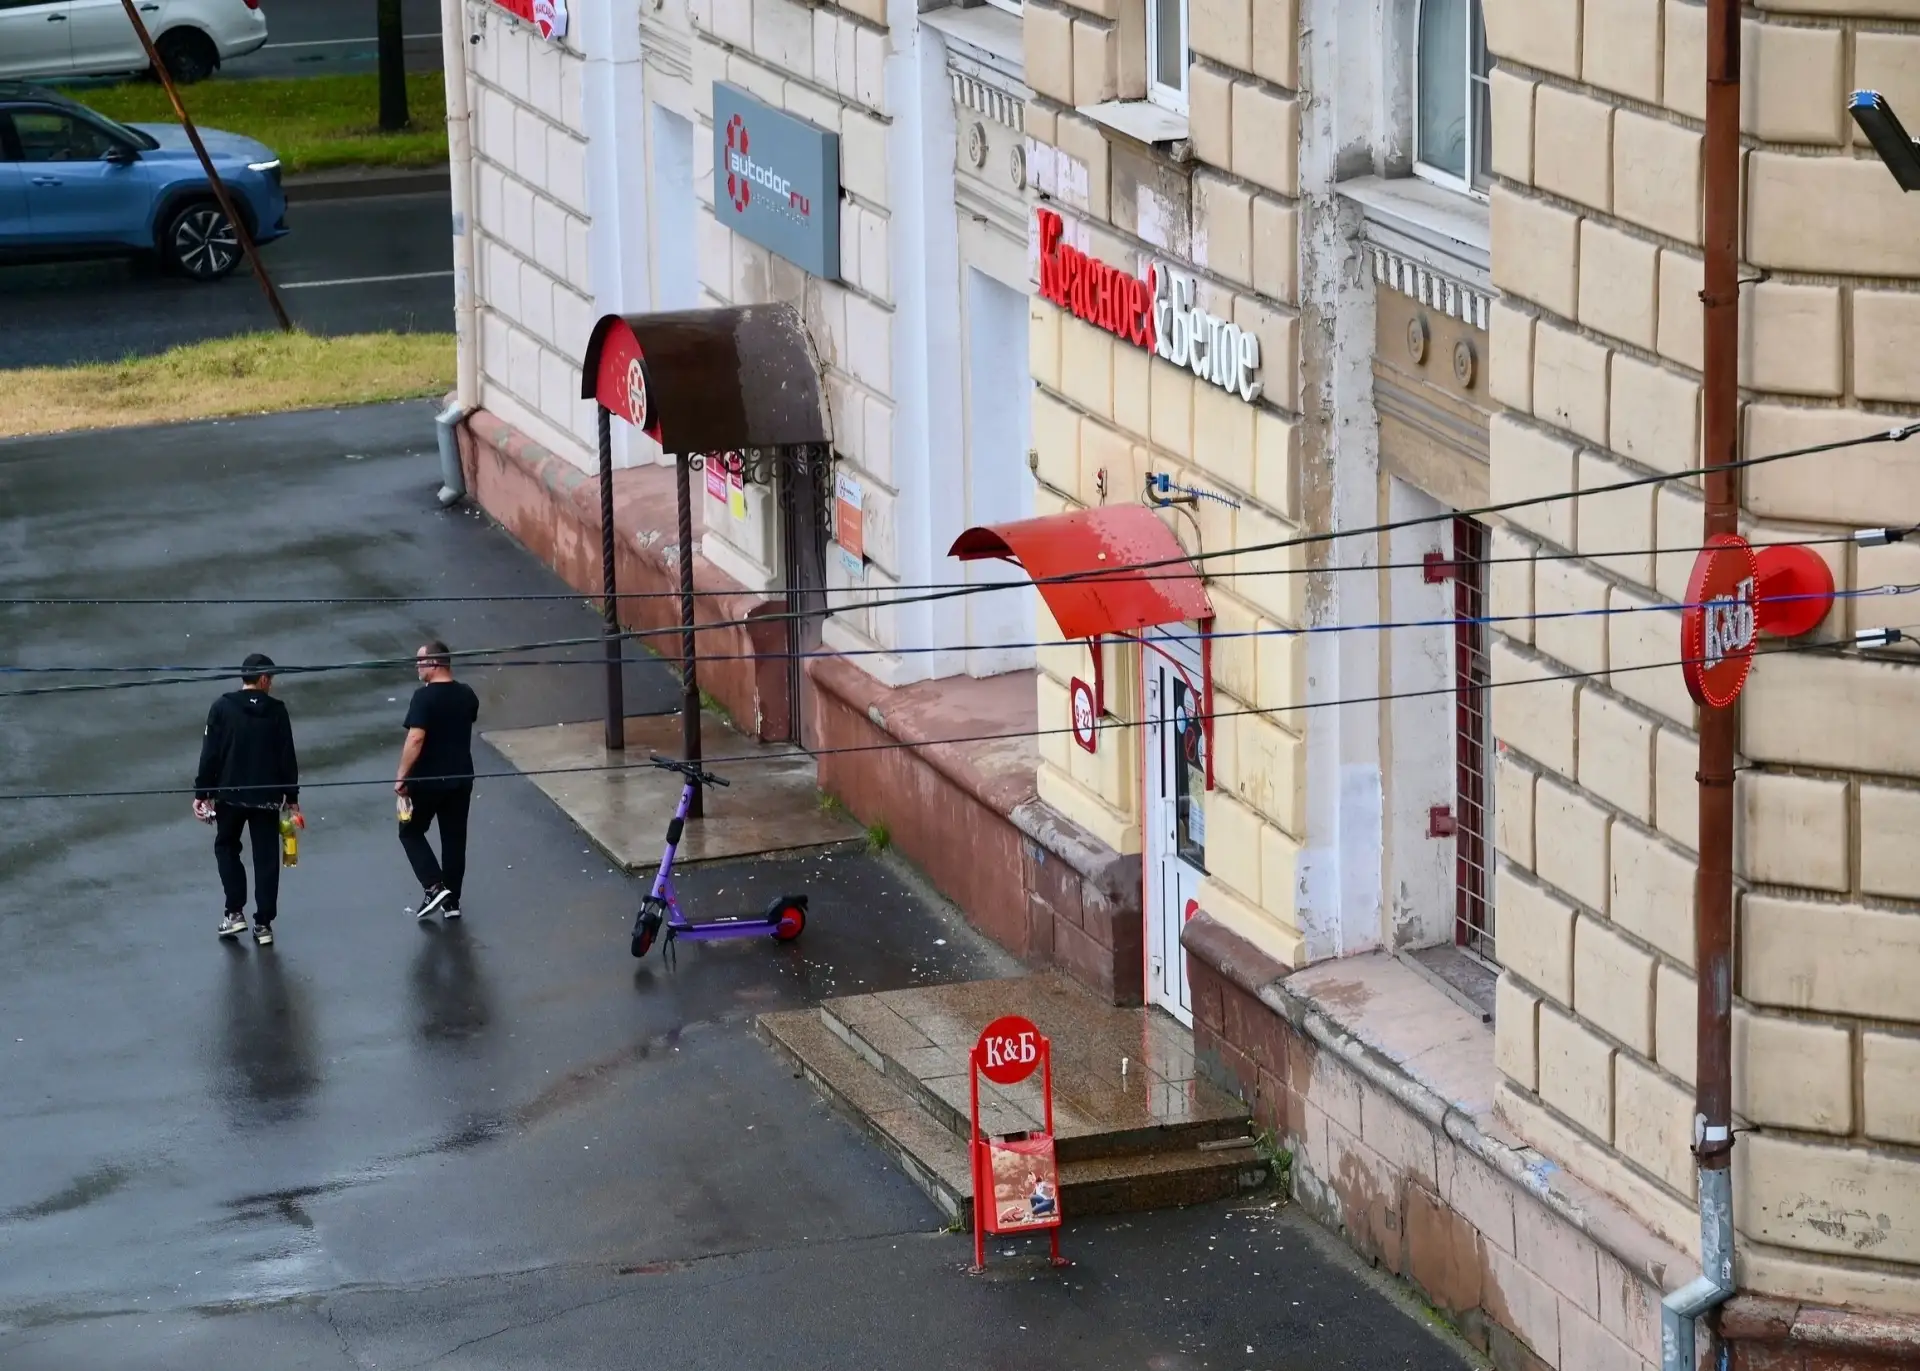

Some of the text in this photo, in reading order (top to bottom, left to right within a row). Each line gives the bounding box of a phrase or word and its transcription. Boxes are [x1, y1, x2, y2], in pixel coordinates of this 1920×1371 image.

[731, 152, 810, 217] autodoc.ru
[1704, 576, 1755, 670] К&Б
[985, 1031, 1036, 1068] К&Б
